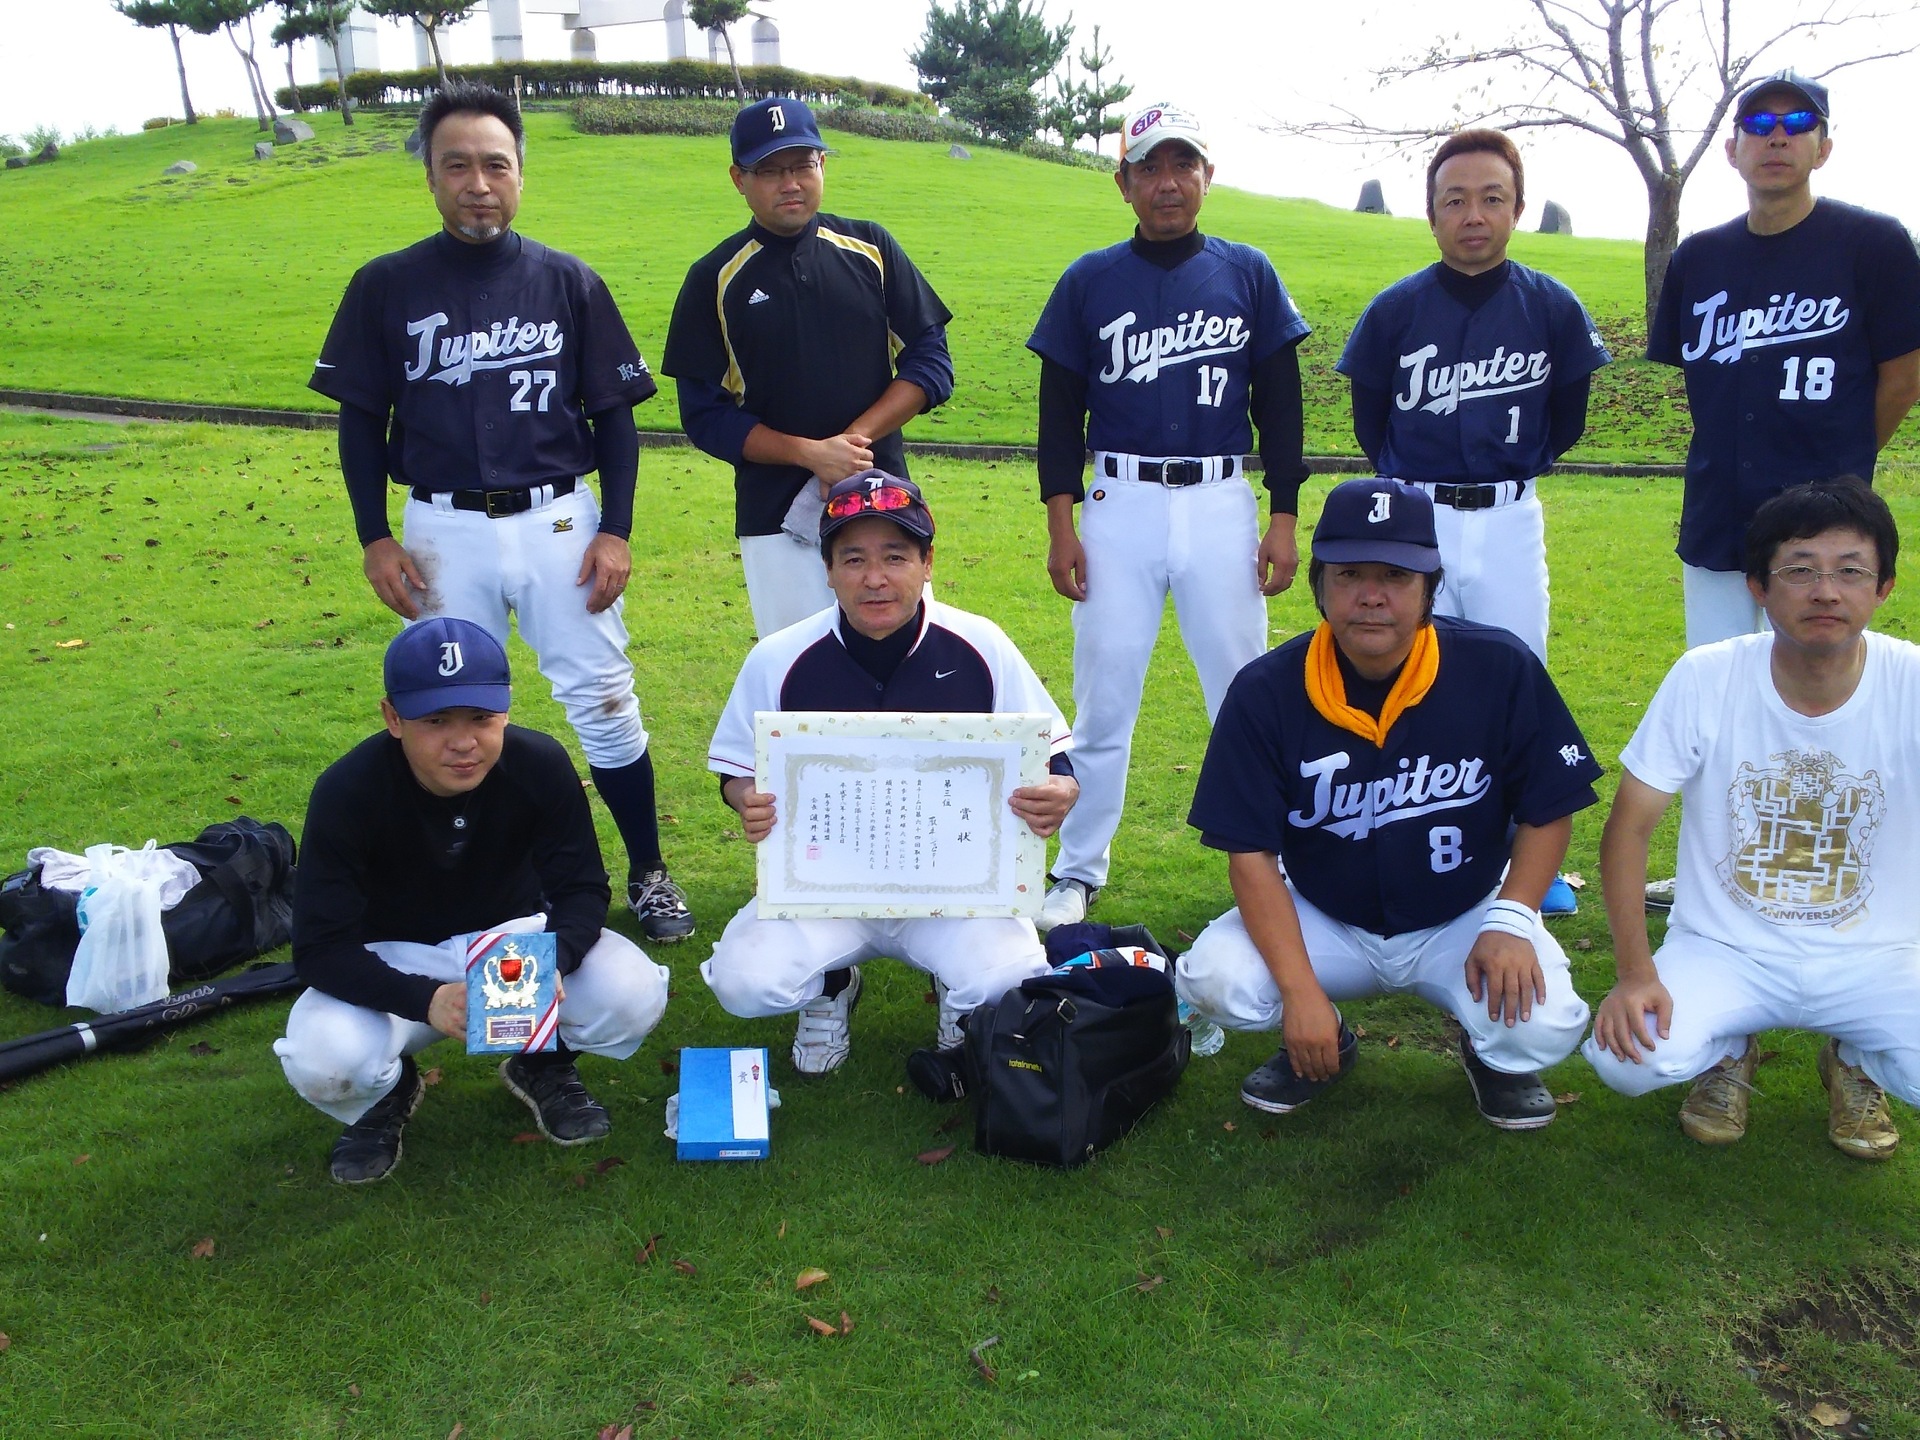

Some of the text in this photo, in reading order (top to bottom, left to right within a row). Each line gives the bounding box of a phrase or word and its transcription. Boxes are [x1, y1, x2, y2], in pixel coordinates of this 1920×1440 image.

[1135, 110, 1158, 134] STP
[404, 311, 564, 387] Jupiter
[1098, 309, 1251, 384] Jupiter
[1681, 290, 1850, 365] Jupiter
[508, 369, 557, 412] 27
[1196, 364, 1229, 408] 17
[1395, 343, 1552, 417] Jupiter
[1778, 356, 1836, 401] 18
[1504, 405, 1521, 444] 1
[942, 779, 952, 807] 第三位
[1287, 750, 1493, 842] Jupiter
[957, 807, 972, 843] 賞状
[1428, 825, 1463, 874] 8
[1757, 901, 1853, 921] ANNIVERSARY
